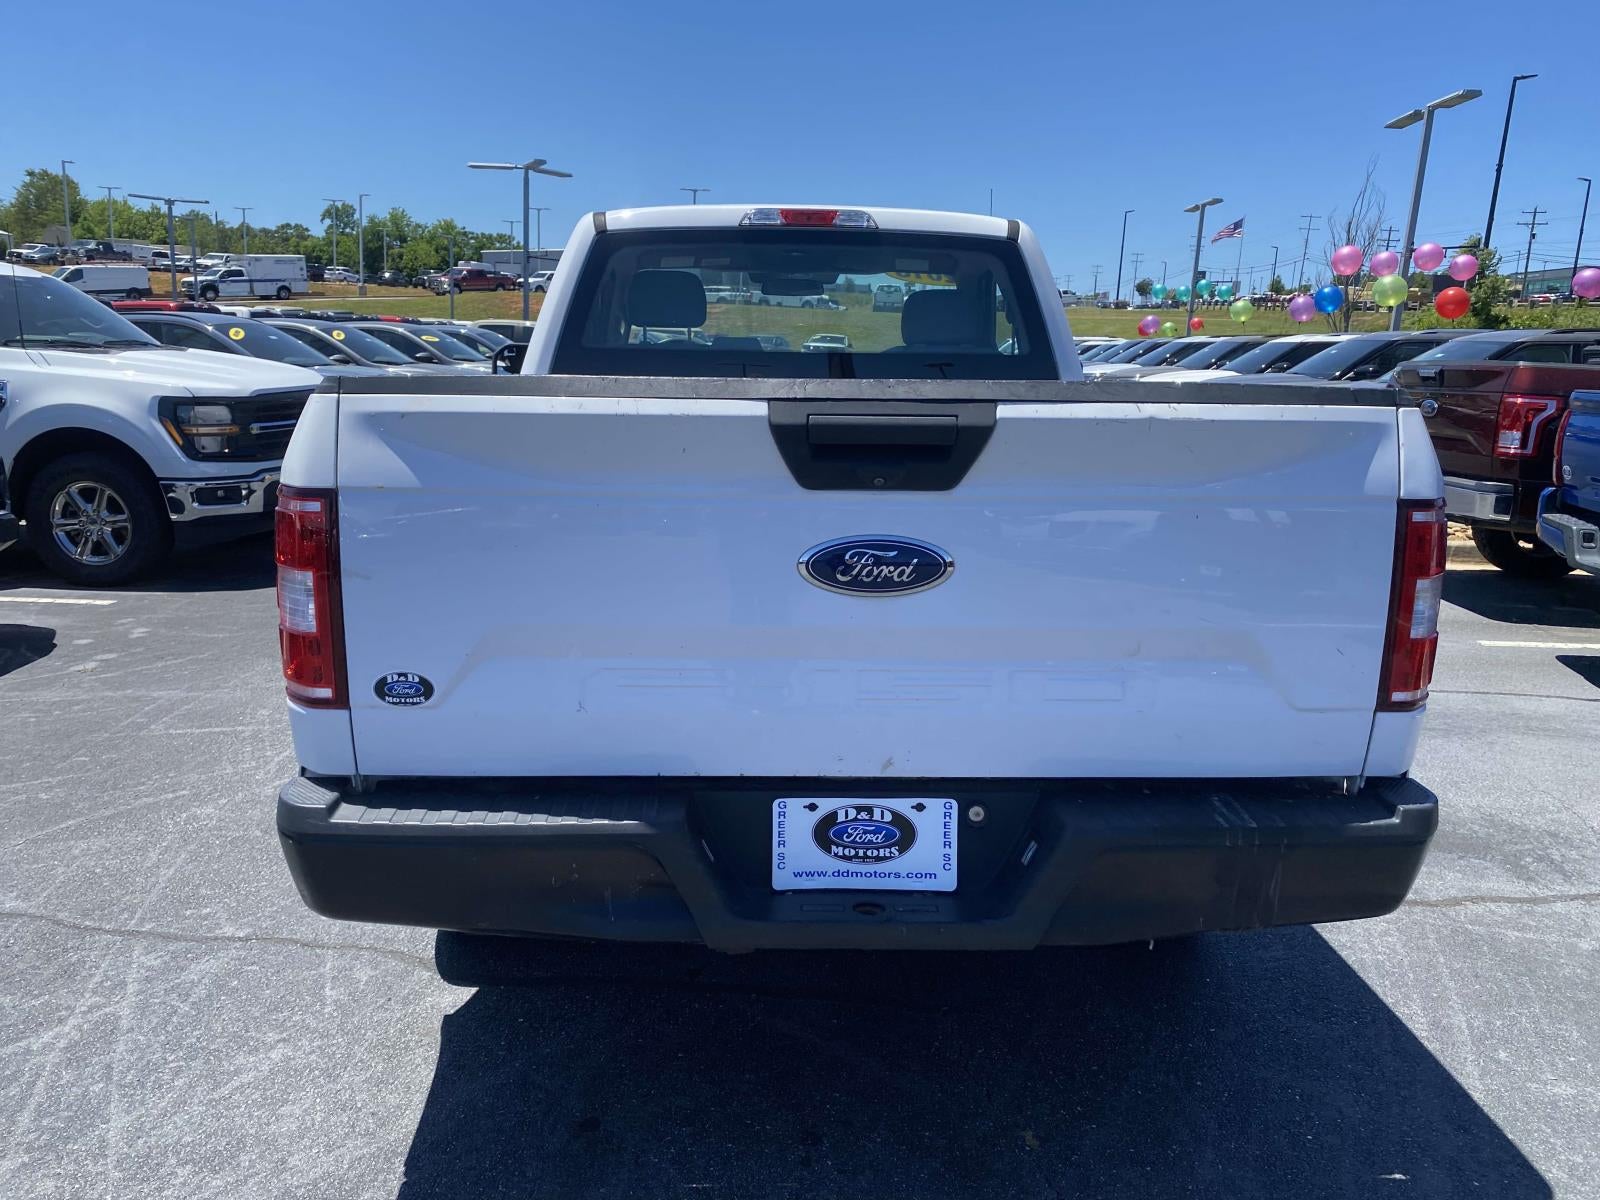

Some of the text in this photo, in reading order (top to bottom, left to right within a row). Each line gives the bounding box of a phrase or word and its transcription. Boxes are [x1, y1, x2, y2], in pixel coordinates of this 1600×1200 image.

[836, 548, 919, 582] Ford
[392, 684, 417, 694] Ford
[835, 807, 893, 823] D&D
[777, 801, 787, 870] GREER SC
[843, 825, 886, 844] Ford
[942, 801, 953, 871] GREER SC
[831, 845, 900, 857] MOTORS
[793, 869, 937, 880] www.ddmotors.com
